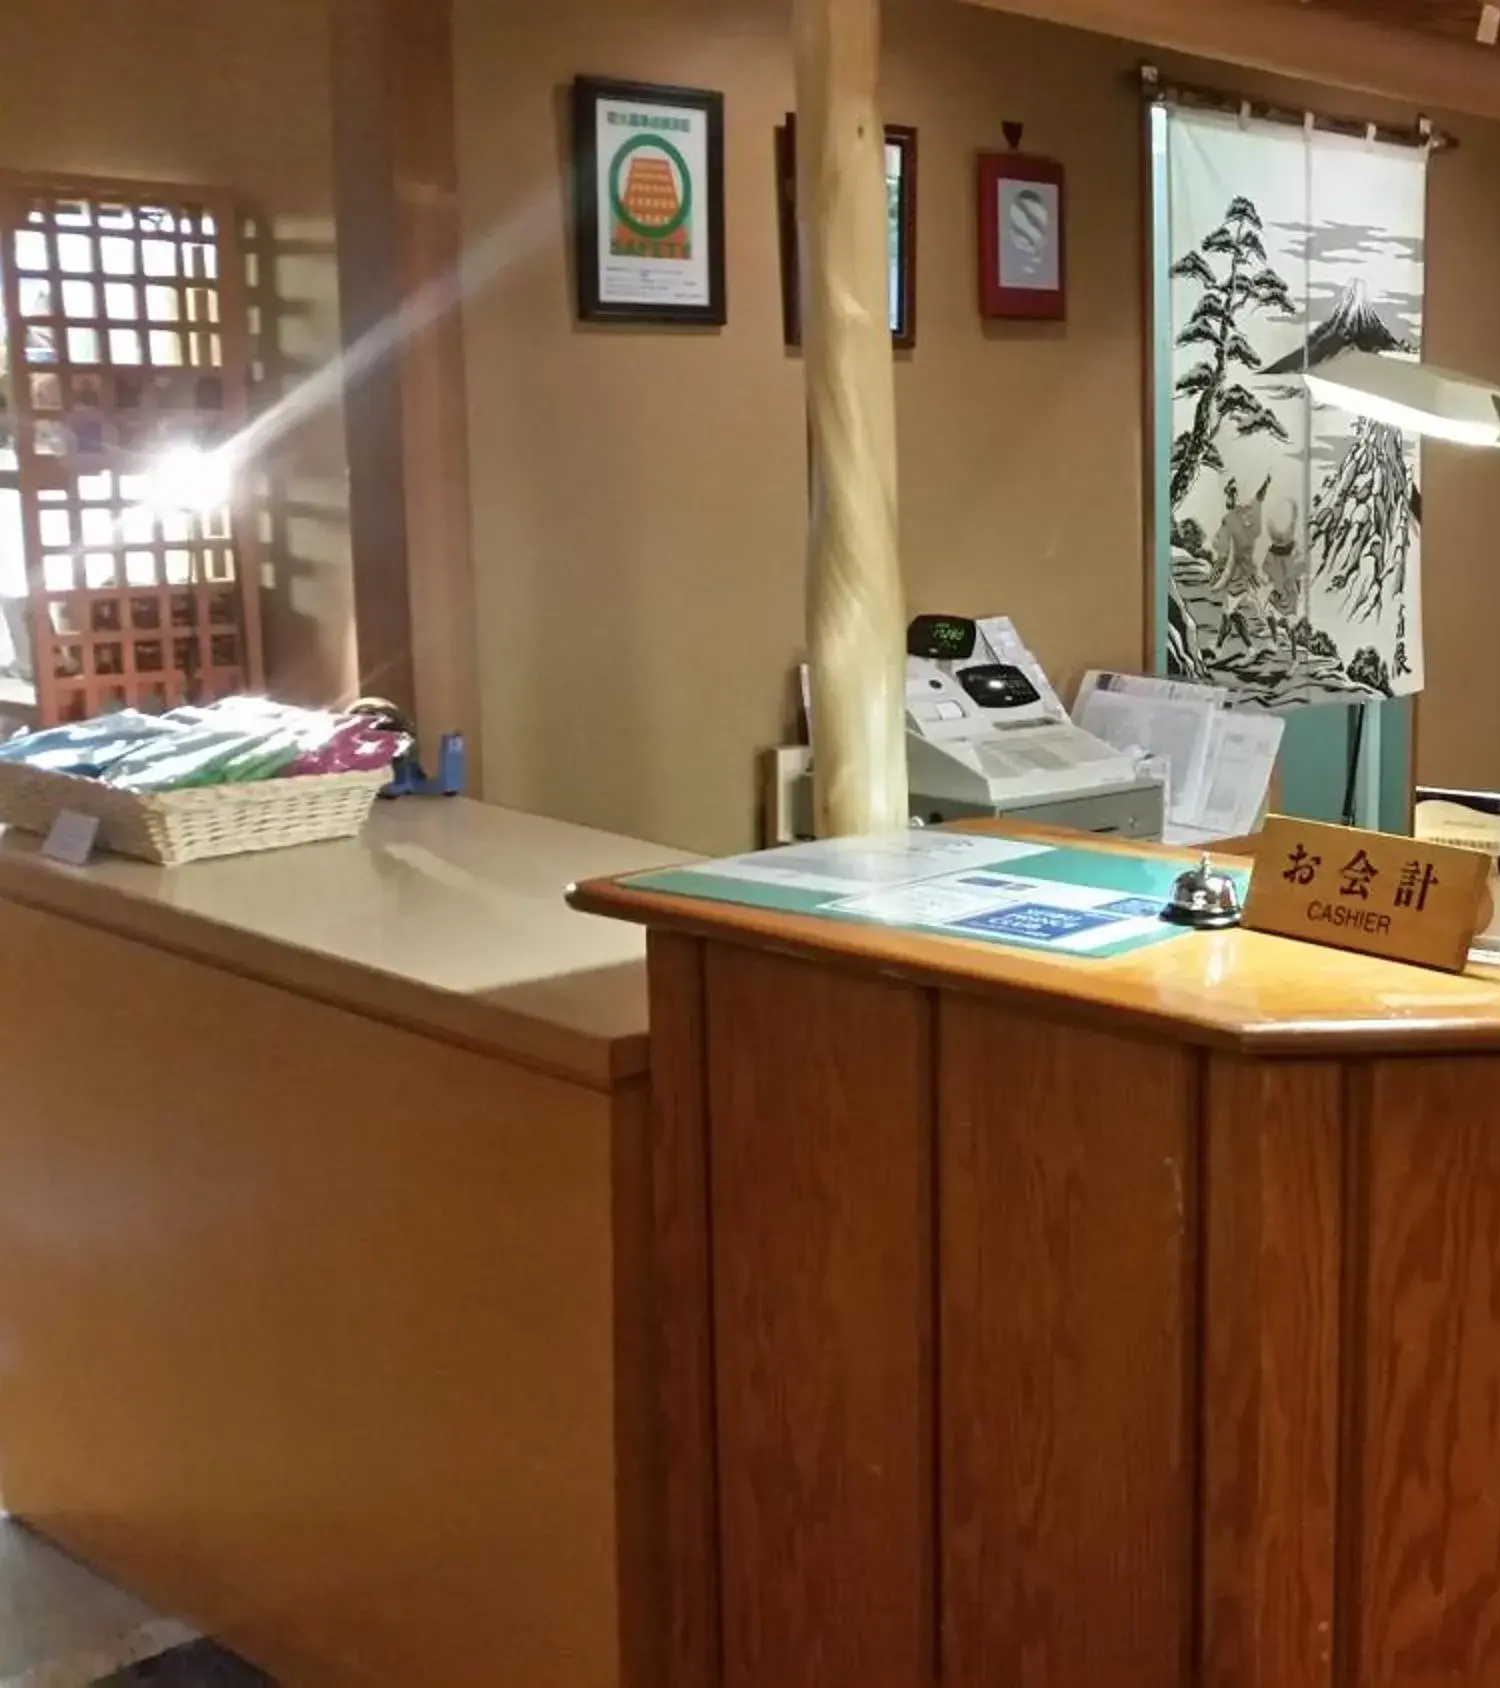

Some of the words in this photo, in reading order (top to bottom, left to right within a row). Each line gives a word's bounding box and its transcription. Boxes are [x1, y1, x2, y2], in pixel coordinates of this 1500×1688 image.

[1282, 842, 1439, 912] お会計
[1306, 900, 1392, 936] CASHIER
